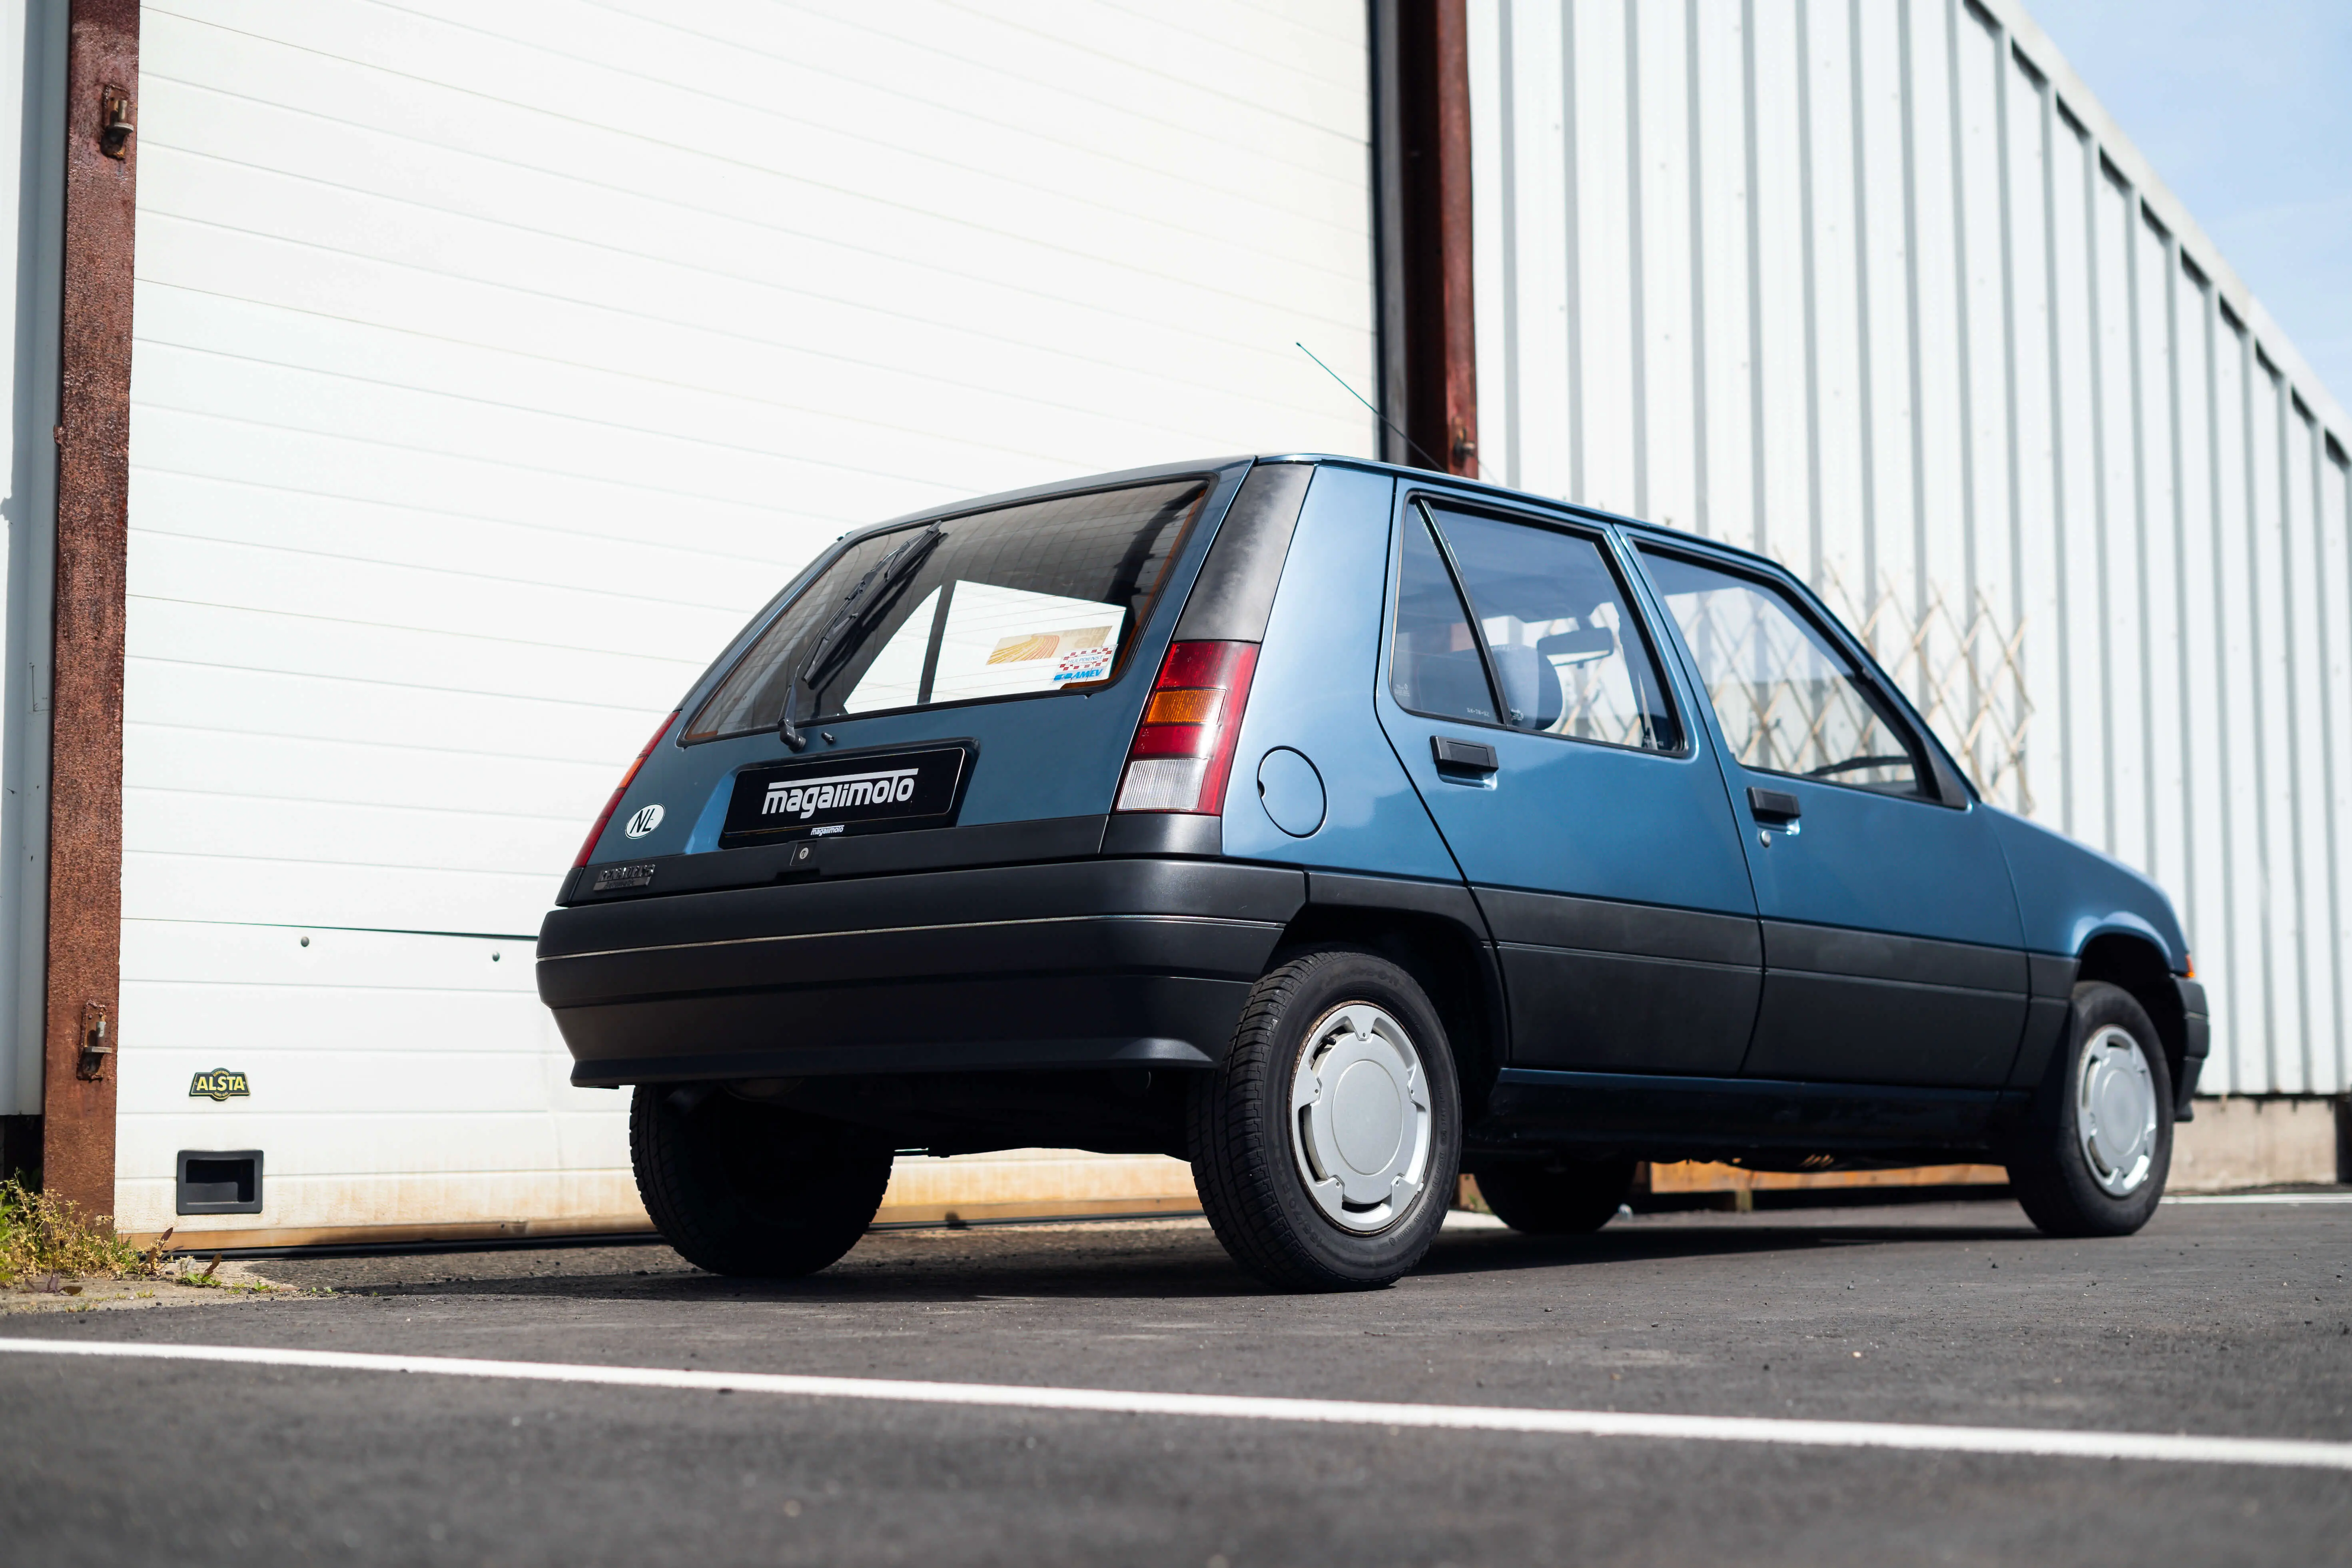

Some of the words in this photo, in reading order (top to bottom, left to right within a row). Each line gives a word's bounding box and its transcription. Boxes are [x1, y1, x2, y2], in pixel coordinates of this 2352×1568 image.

[1068, 655, 1103, 663] HULPDIENST
[1072, 669, 1103, 679] AMEV
[762, 768, 919, 819] magalimoto
[629, 808, 655, 834] NL
[810, 825, 845, 836] magalimoto
[196, 1076, 245, 1091] ALSTA
